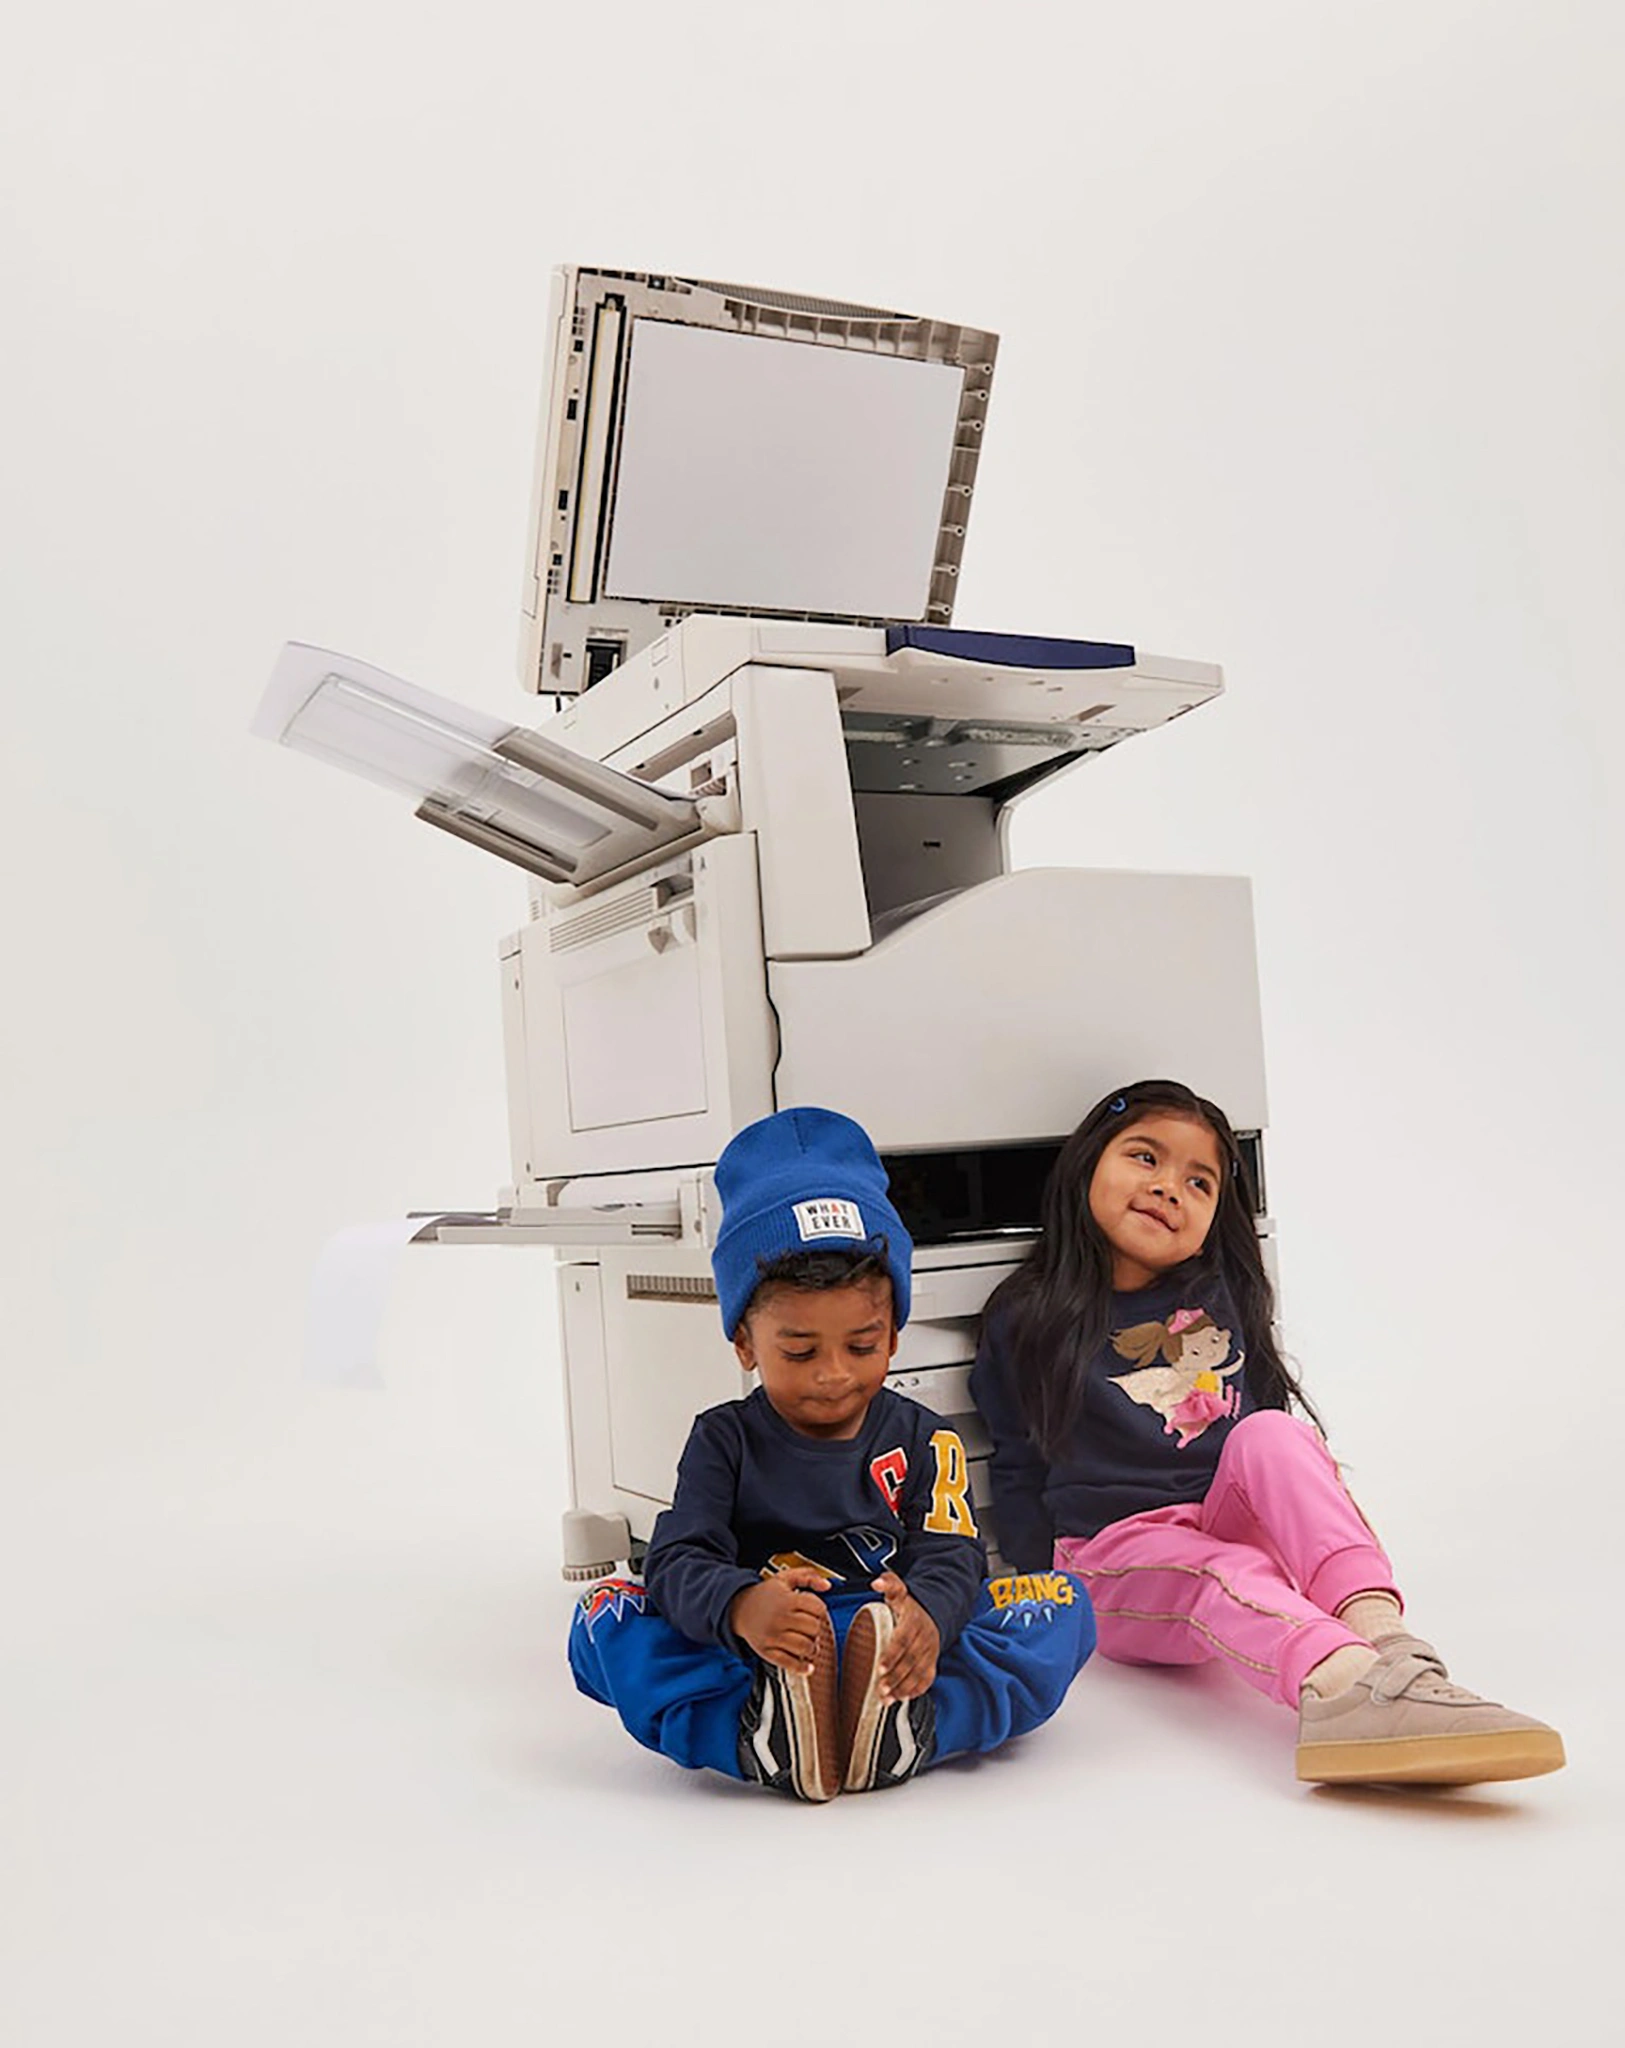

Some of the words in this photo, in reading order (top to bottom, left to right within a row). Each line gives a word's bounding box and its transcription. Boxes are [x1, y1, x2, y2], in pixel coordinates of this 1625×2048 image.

[806, 1202, 848, 1216] WHAT
[811, 1215, 852, 1230] EVER
[923, 1429, 978, 1538] R
[988, 1574, 1074, 1609] BANG
